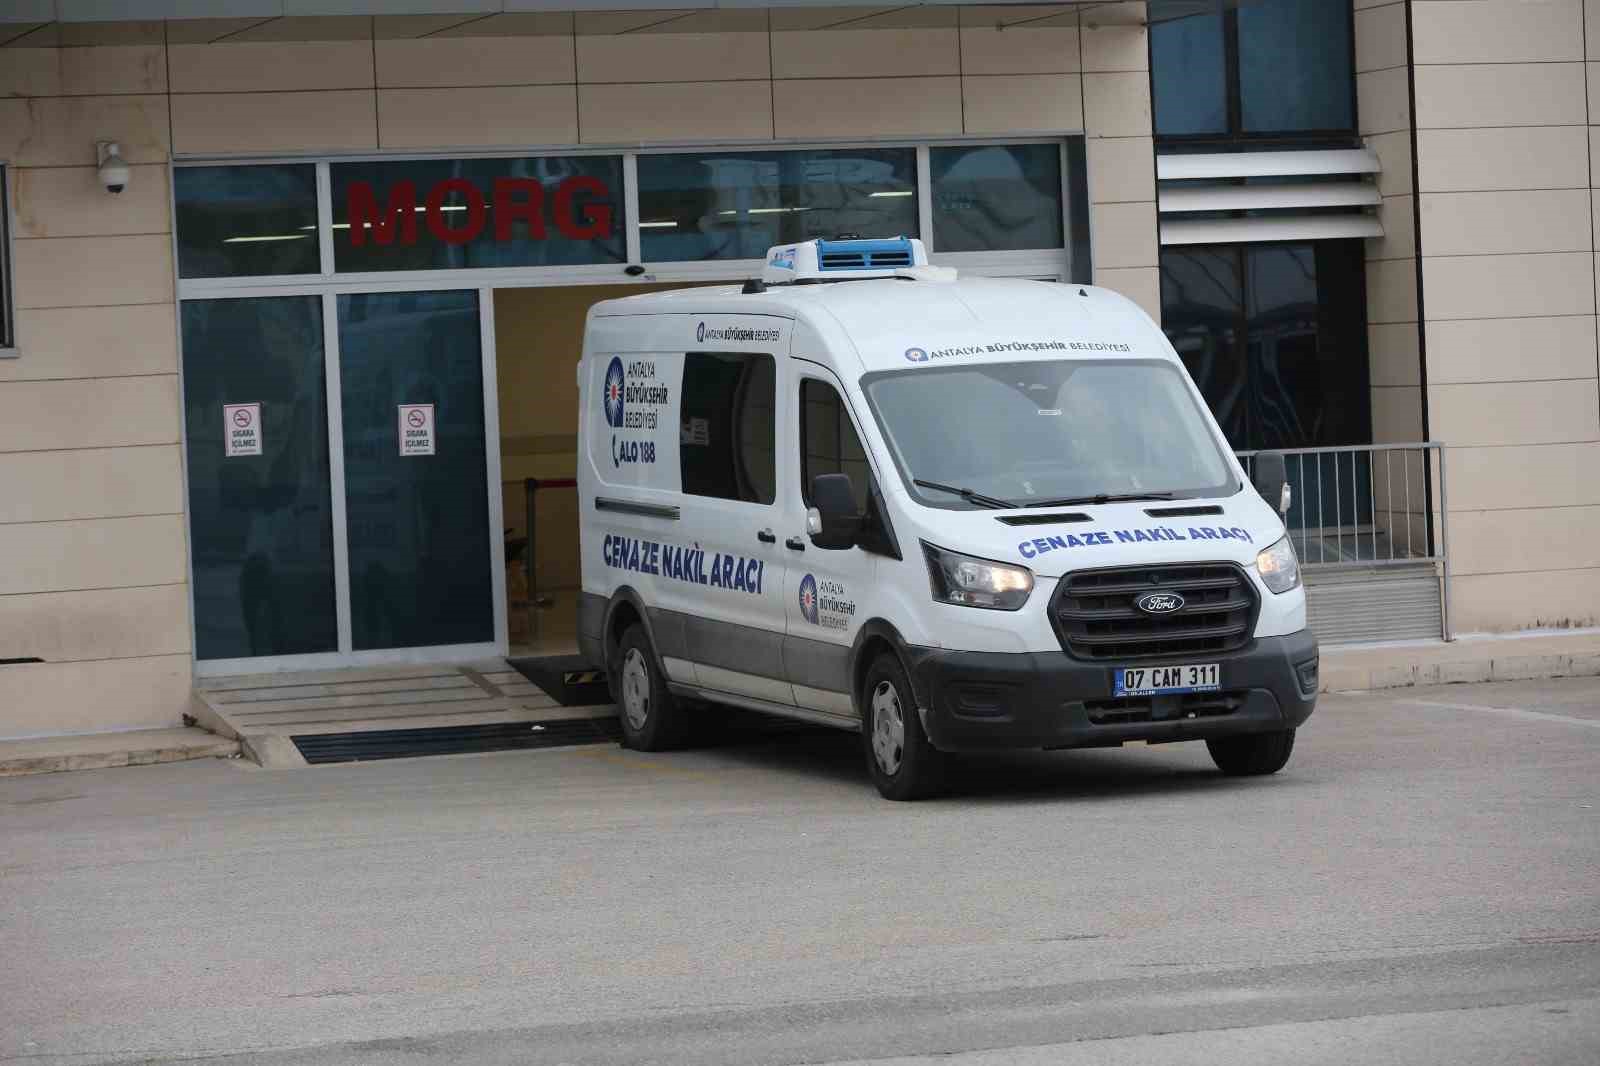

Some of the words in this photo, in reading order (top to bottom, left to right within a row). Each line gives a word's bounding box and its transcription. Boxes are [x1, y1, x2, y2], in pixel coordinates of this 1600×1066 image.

[345, 176, 611, 248] MORG
[930, 346, 984, 360] ANTALYA
[985, 340, 1067, 353] BÜYÜKŞEHİR
[1070, 342, 1130, 352] BELEDİYESİ
[627, 361, 655, 378] ANTALYA
[625, 383, 668, 405] BÜYÜKŞEHİR
[625, 409, 658, 430] BELEDİYESİ
[619, 441, 638, 463] ALO
[639, 441, 656, 463] 188
[1018, 530, 1113, 558] CENAZE
[1113, 526, 1186, 544] NAKİL
[603, 534, 660, 576] CENAZE
[662, 541, 708, 585] NAKİL
[710, 552, 764, 595] ARACI
[819, 580, 845, 594] ANTALYA
[1147, 597, 1177, 610] Ford
[1125, 669, 1145, 689] 07
[1152, 667, 1181, 688] CAM
[1189, 665, 1217, 686] 311
